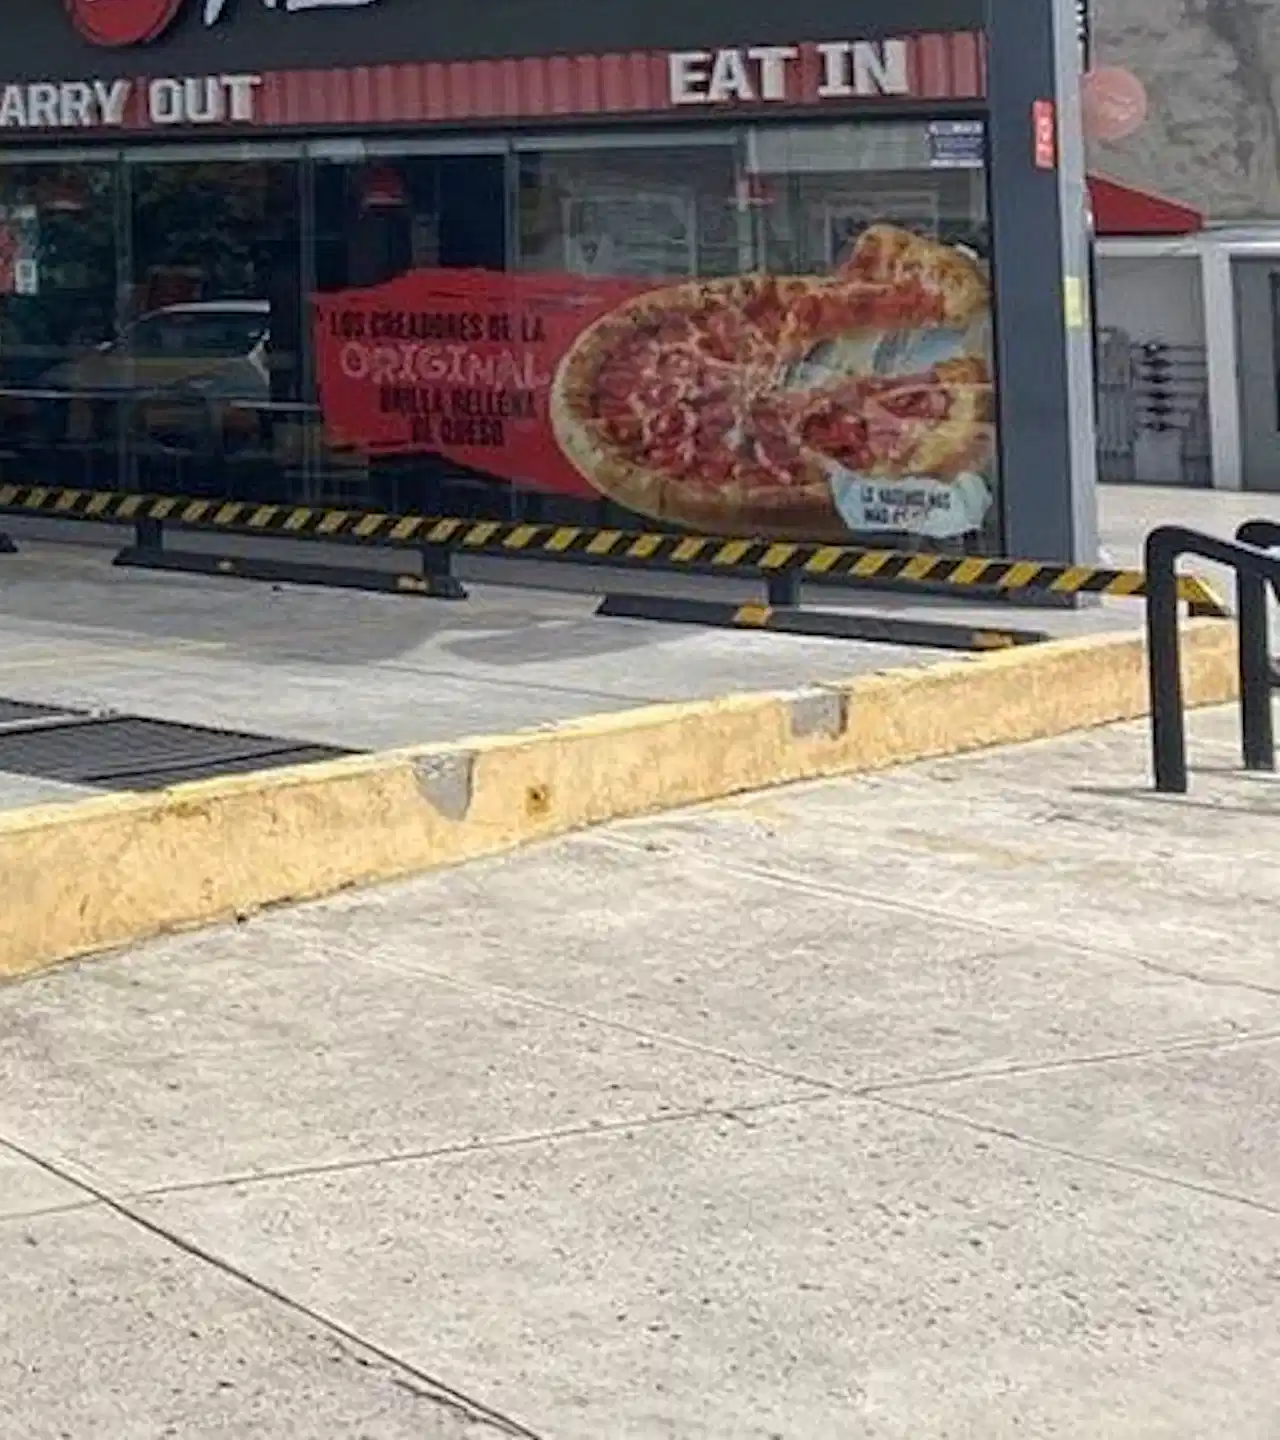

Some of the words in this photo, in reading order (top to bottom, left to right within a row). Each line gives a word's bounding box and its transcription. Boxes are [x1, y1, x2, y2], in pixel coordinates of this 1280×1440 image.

[668, 45, 799, 105] EAT
[817, 39, 909, 98] IN
[148, 73, 262, 124] OUT
[339, 340, 551, 392] ORIGINAL
